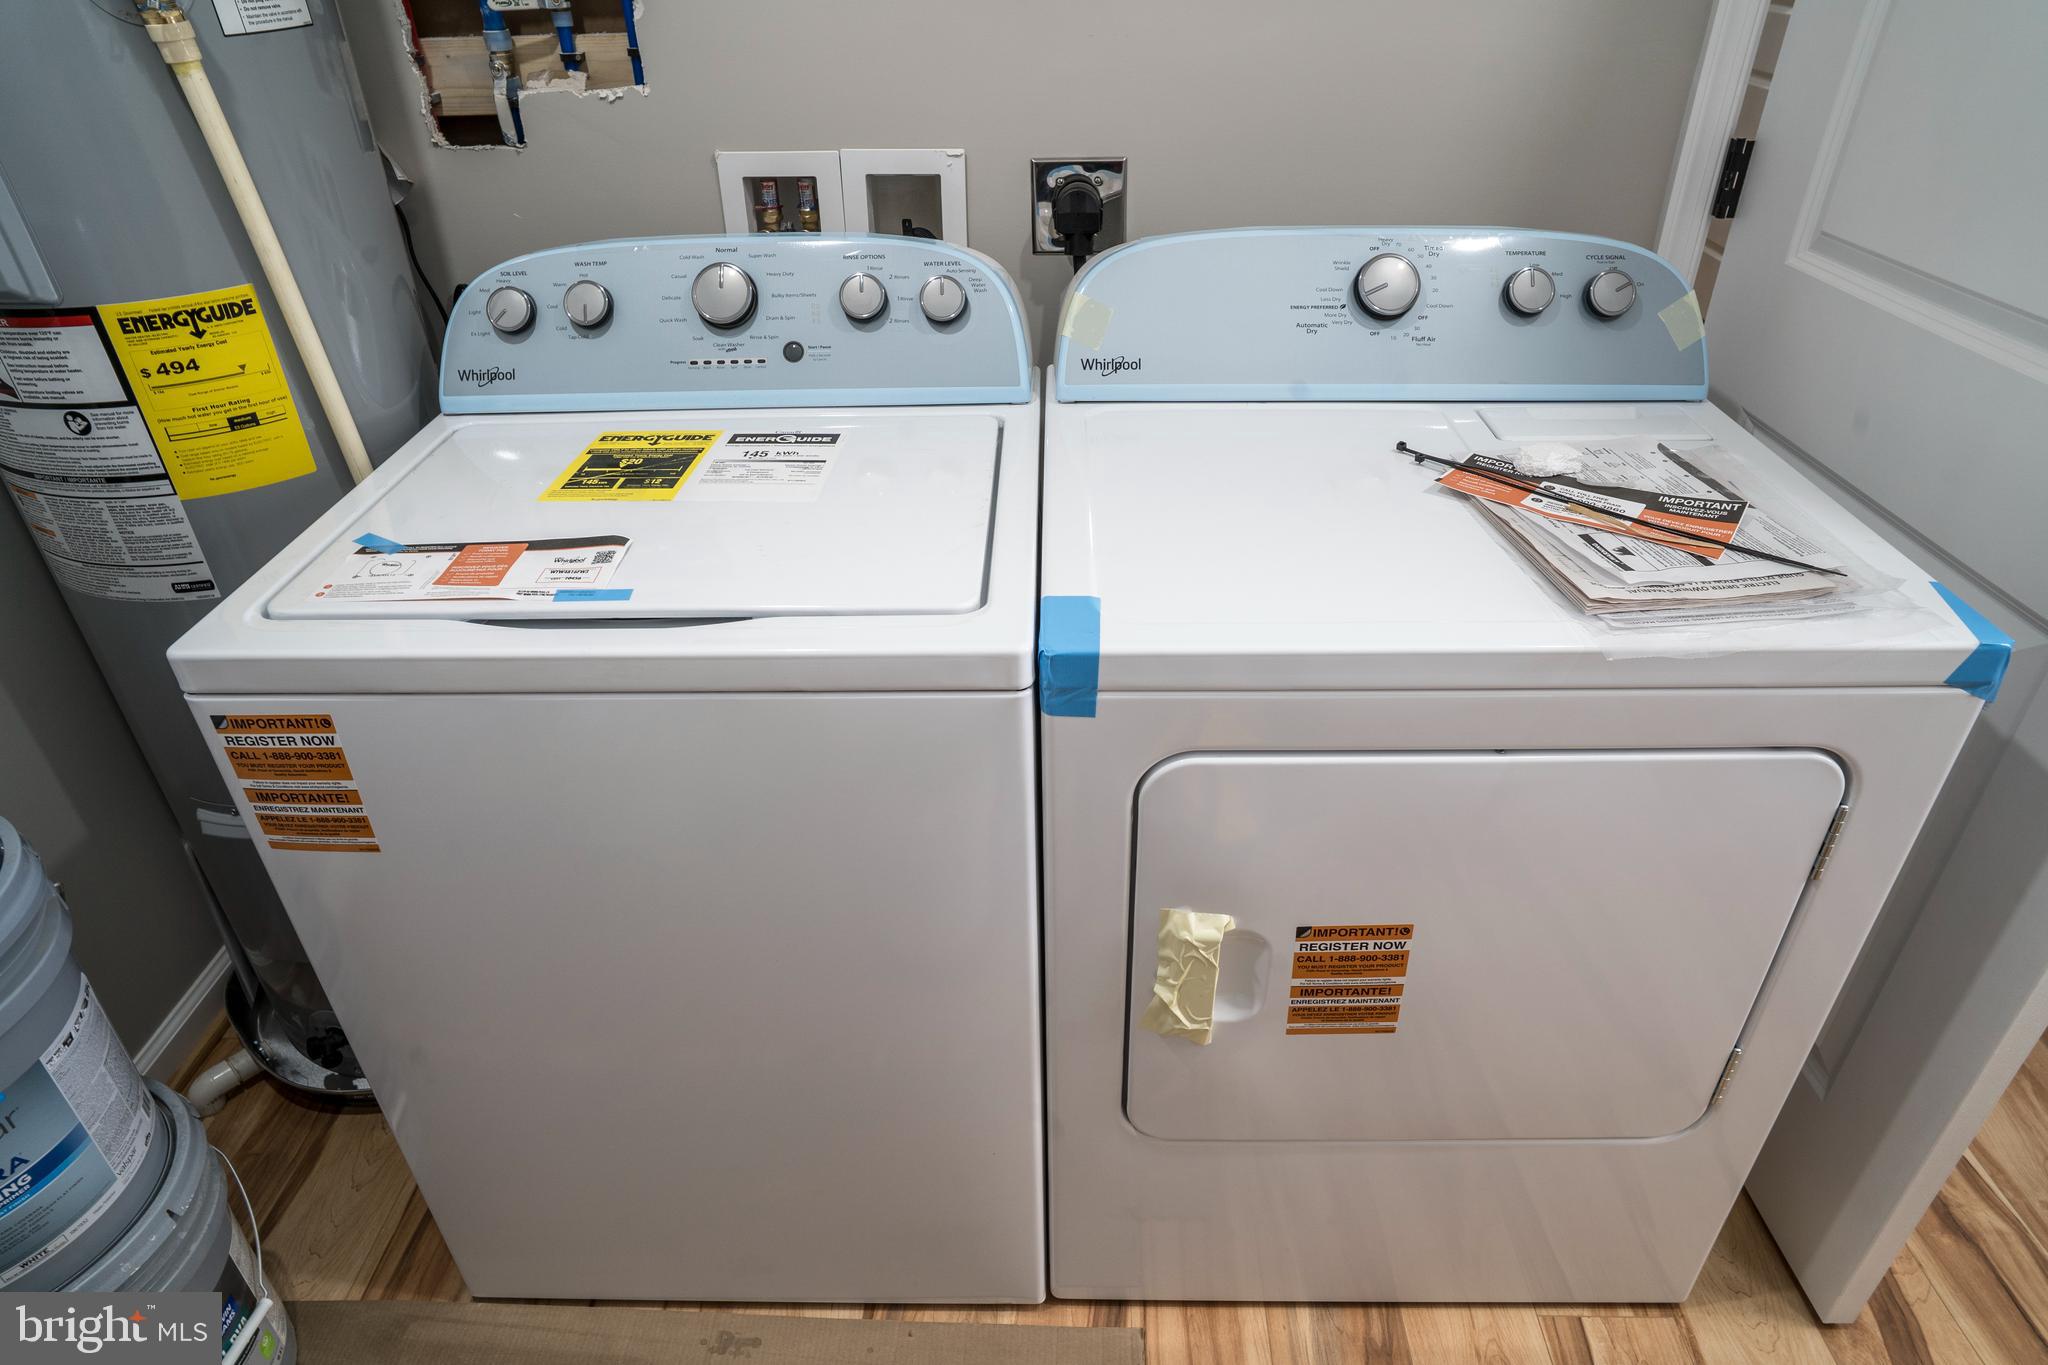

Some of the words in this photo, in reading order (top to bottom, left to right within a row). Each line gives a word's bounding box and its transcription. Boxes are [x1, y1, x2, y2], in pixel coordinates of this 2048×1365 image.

[116, 297, 258, 337] ENERGYGUIDE
[1306, 328, 1318, 336] Dry
[149, 346, 177, 356] Estimated
[177, 344, 196, 353] Yearly
[196, 342, 215, 351] Energy
[216, 339, 228, 347] Cost
[139, 366, 152, 380] $
[156, 357, 201, 376] 494
[1080, 355, 1141, 377] Whirlpool
[457, 367, 516, 387] Whirlpool
[228, 398, 251, 406] Rating
[598, 434, 716, 445] ENERGYGUIDE
[742, 450, 769, 458] 145
[1473, 455, 1514, 470] IMPOR
[1658, 496, 1742, 511] IMPORTANT
[1664, 504, 1728, 516] INSCRIVEZ-VOUS
[1669, 508, 1720, 519] MAINTENANT
[230, 718, 320, 730] IMPORTANT!
[224, 735, 300, 747] REGISTER
[301, 735, 335, 746] NOW
[231, 751, 261, 760] CALL
[262, 751, 342, 760] 1-888-900-3381
[255, 792, 350, 803] IMPORTANTE!
[253, 805, 310, 813] ENREGISTREZ
[311, 806, 364, 814] MAINTENANT
[1313, 927, 1399, 938] IMPORTANT!
[1299, 942, 1369, 952] REGISTER
[1373, 941, 1407, 950] NOW
[1297, 955, 1326, 963] CALL
[1329, 954, 1405, 962] 1-888-900-3381
[1300, 987, 1392, 997] IMPORTANTE!
[19, 1247, 49, 1270] WHITE
